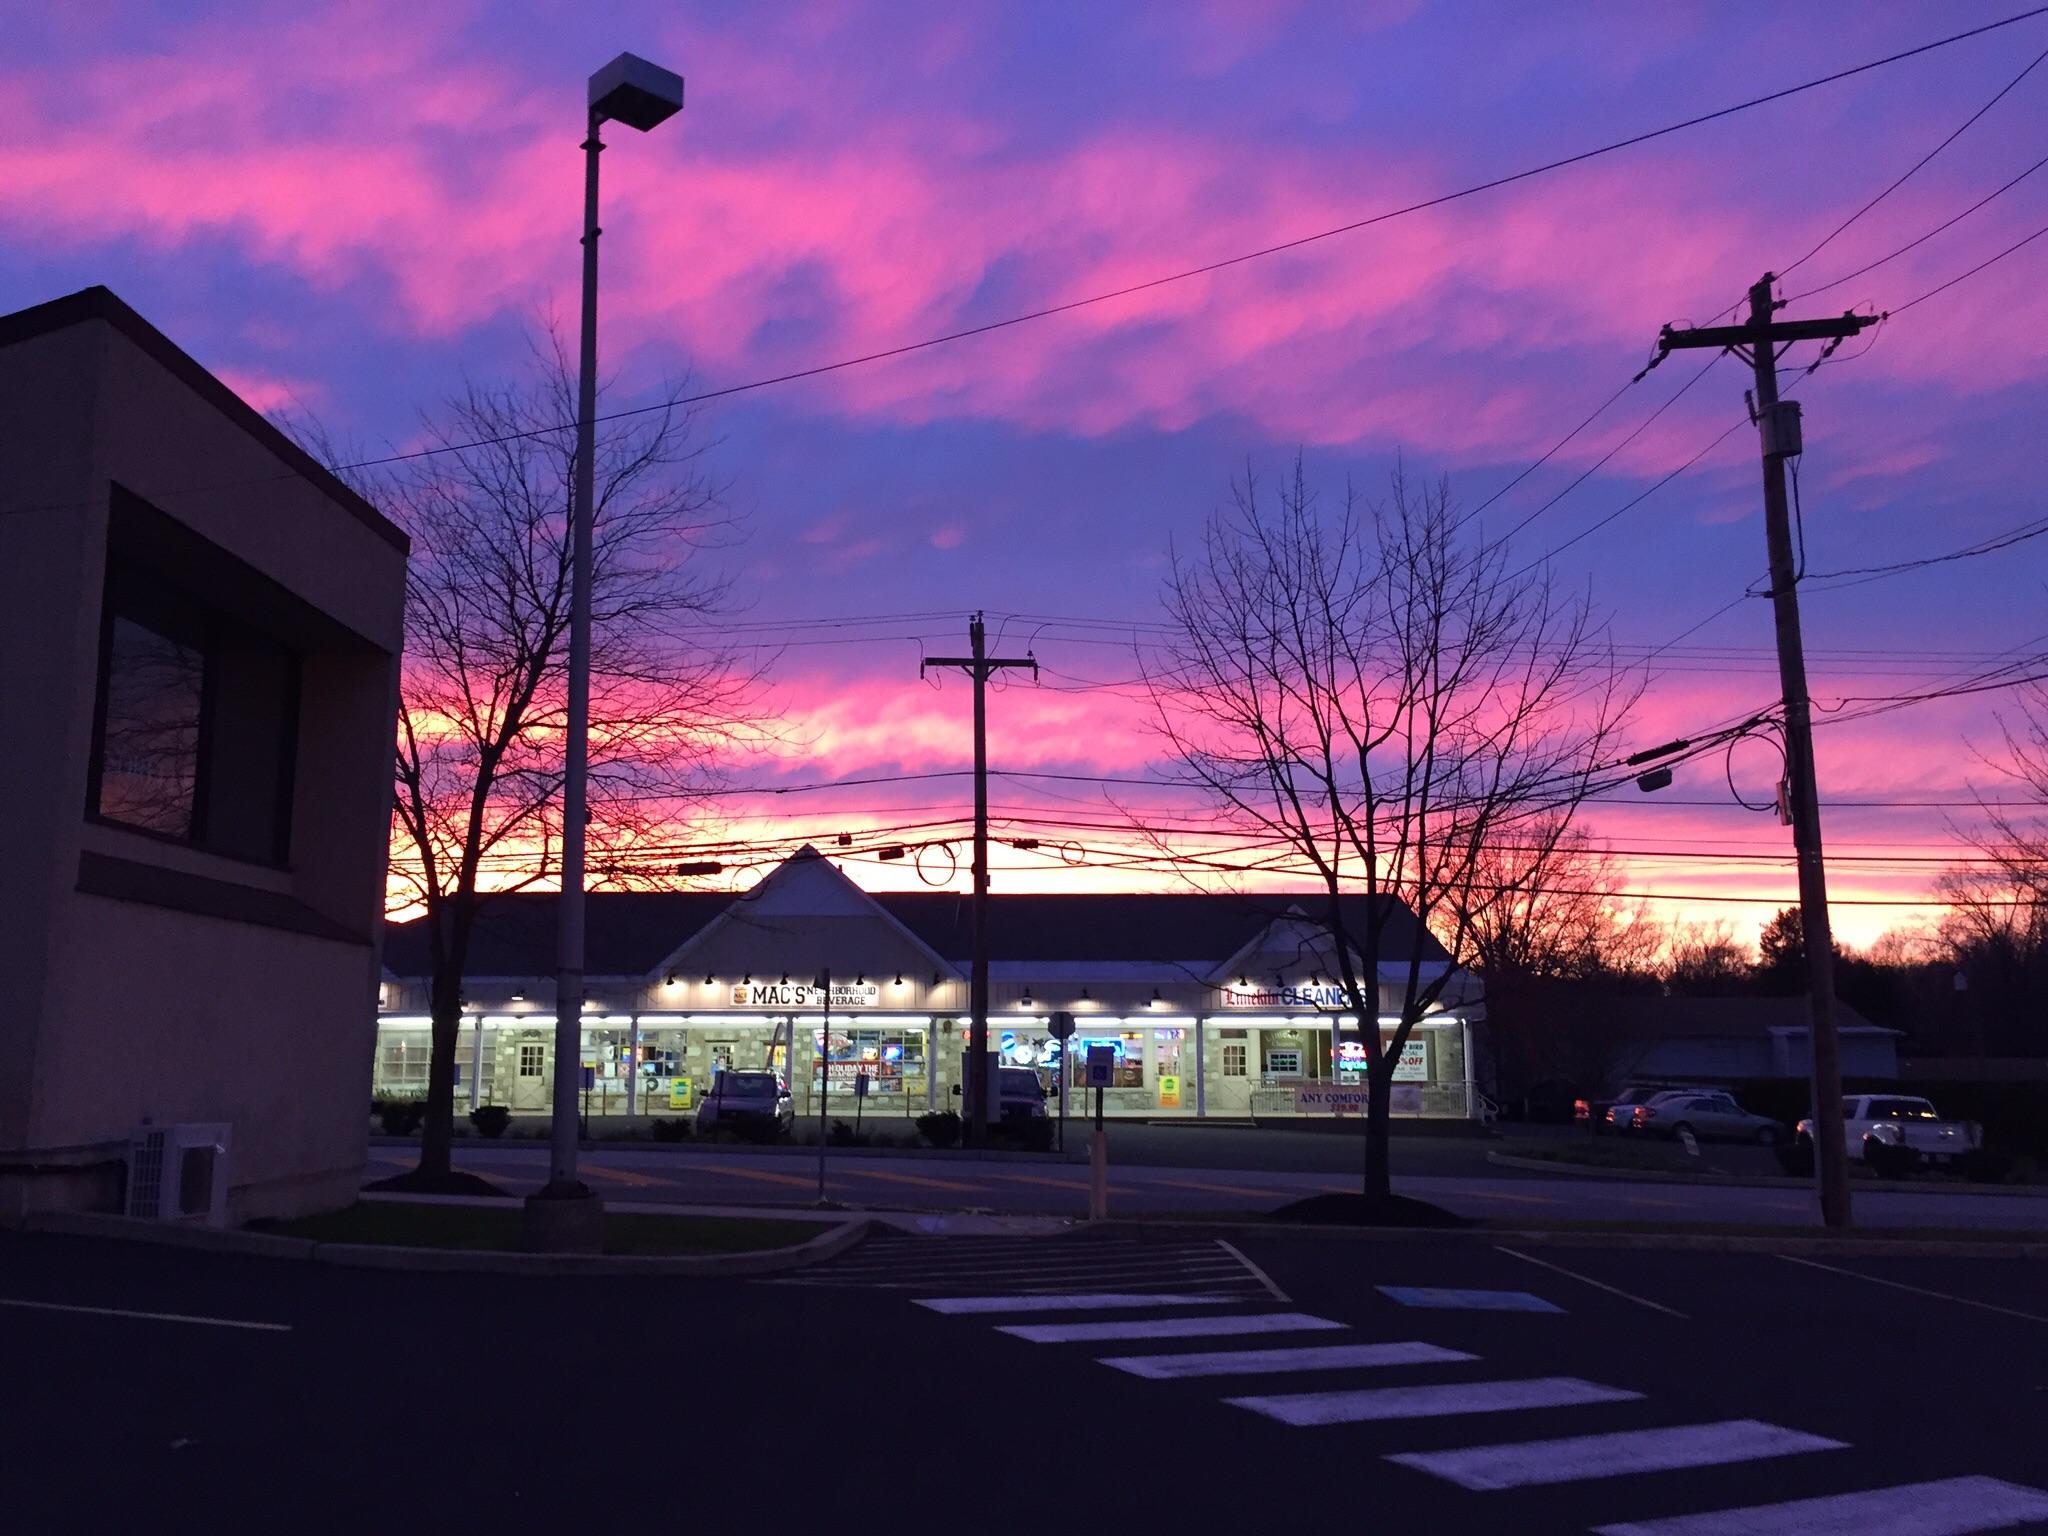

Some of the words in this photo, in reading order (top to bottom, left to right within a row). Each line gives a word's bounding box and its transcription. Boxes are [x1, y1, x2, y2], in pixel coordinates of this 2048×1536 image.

[752, 986, 805, 1004] MAC'S
[806, 986, 876, 996] NEHBORHOOD
[816, 996, 866, 1005] BEVERAGE
[864, 1063, 878, 1073] THE
[1300, 1093, 1322, 1103] ANY
[1325, 1093, 1369, 1103] COMFOR
